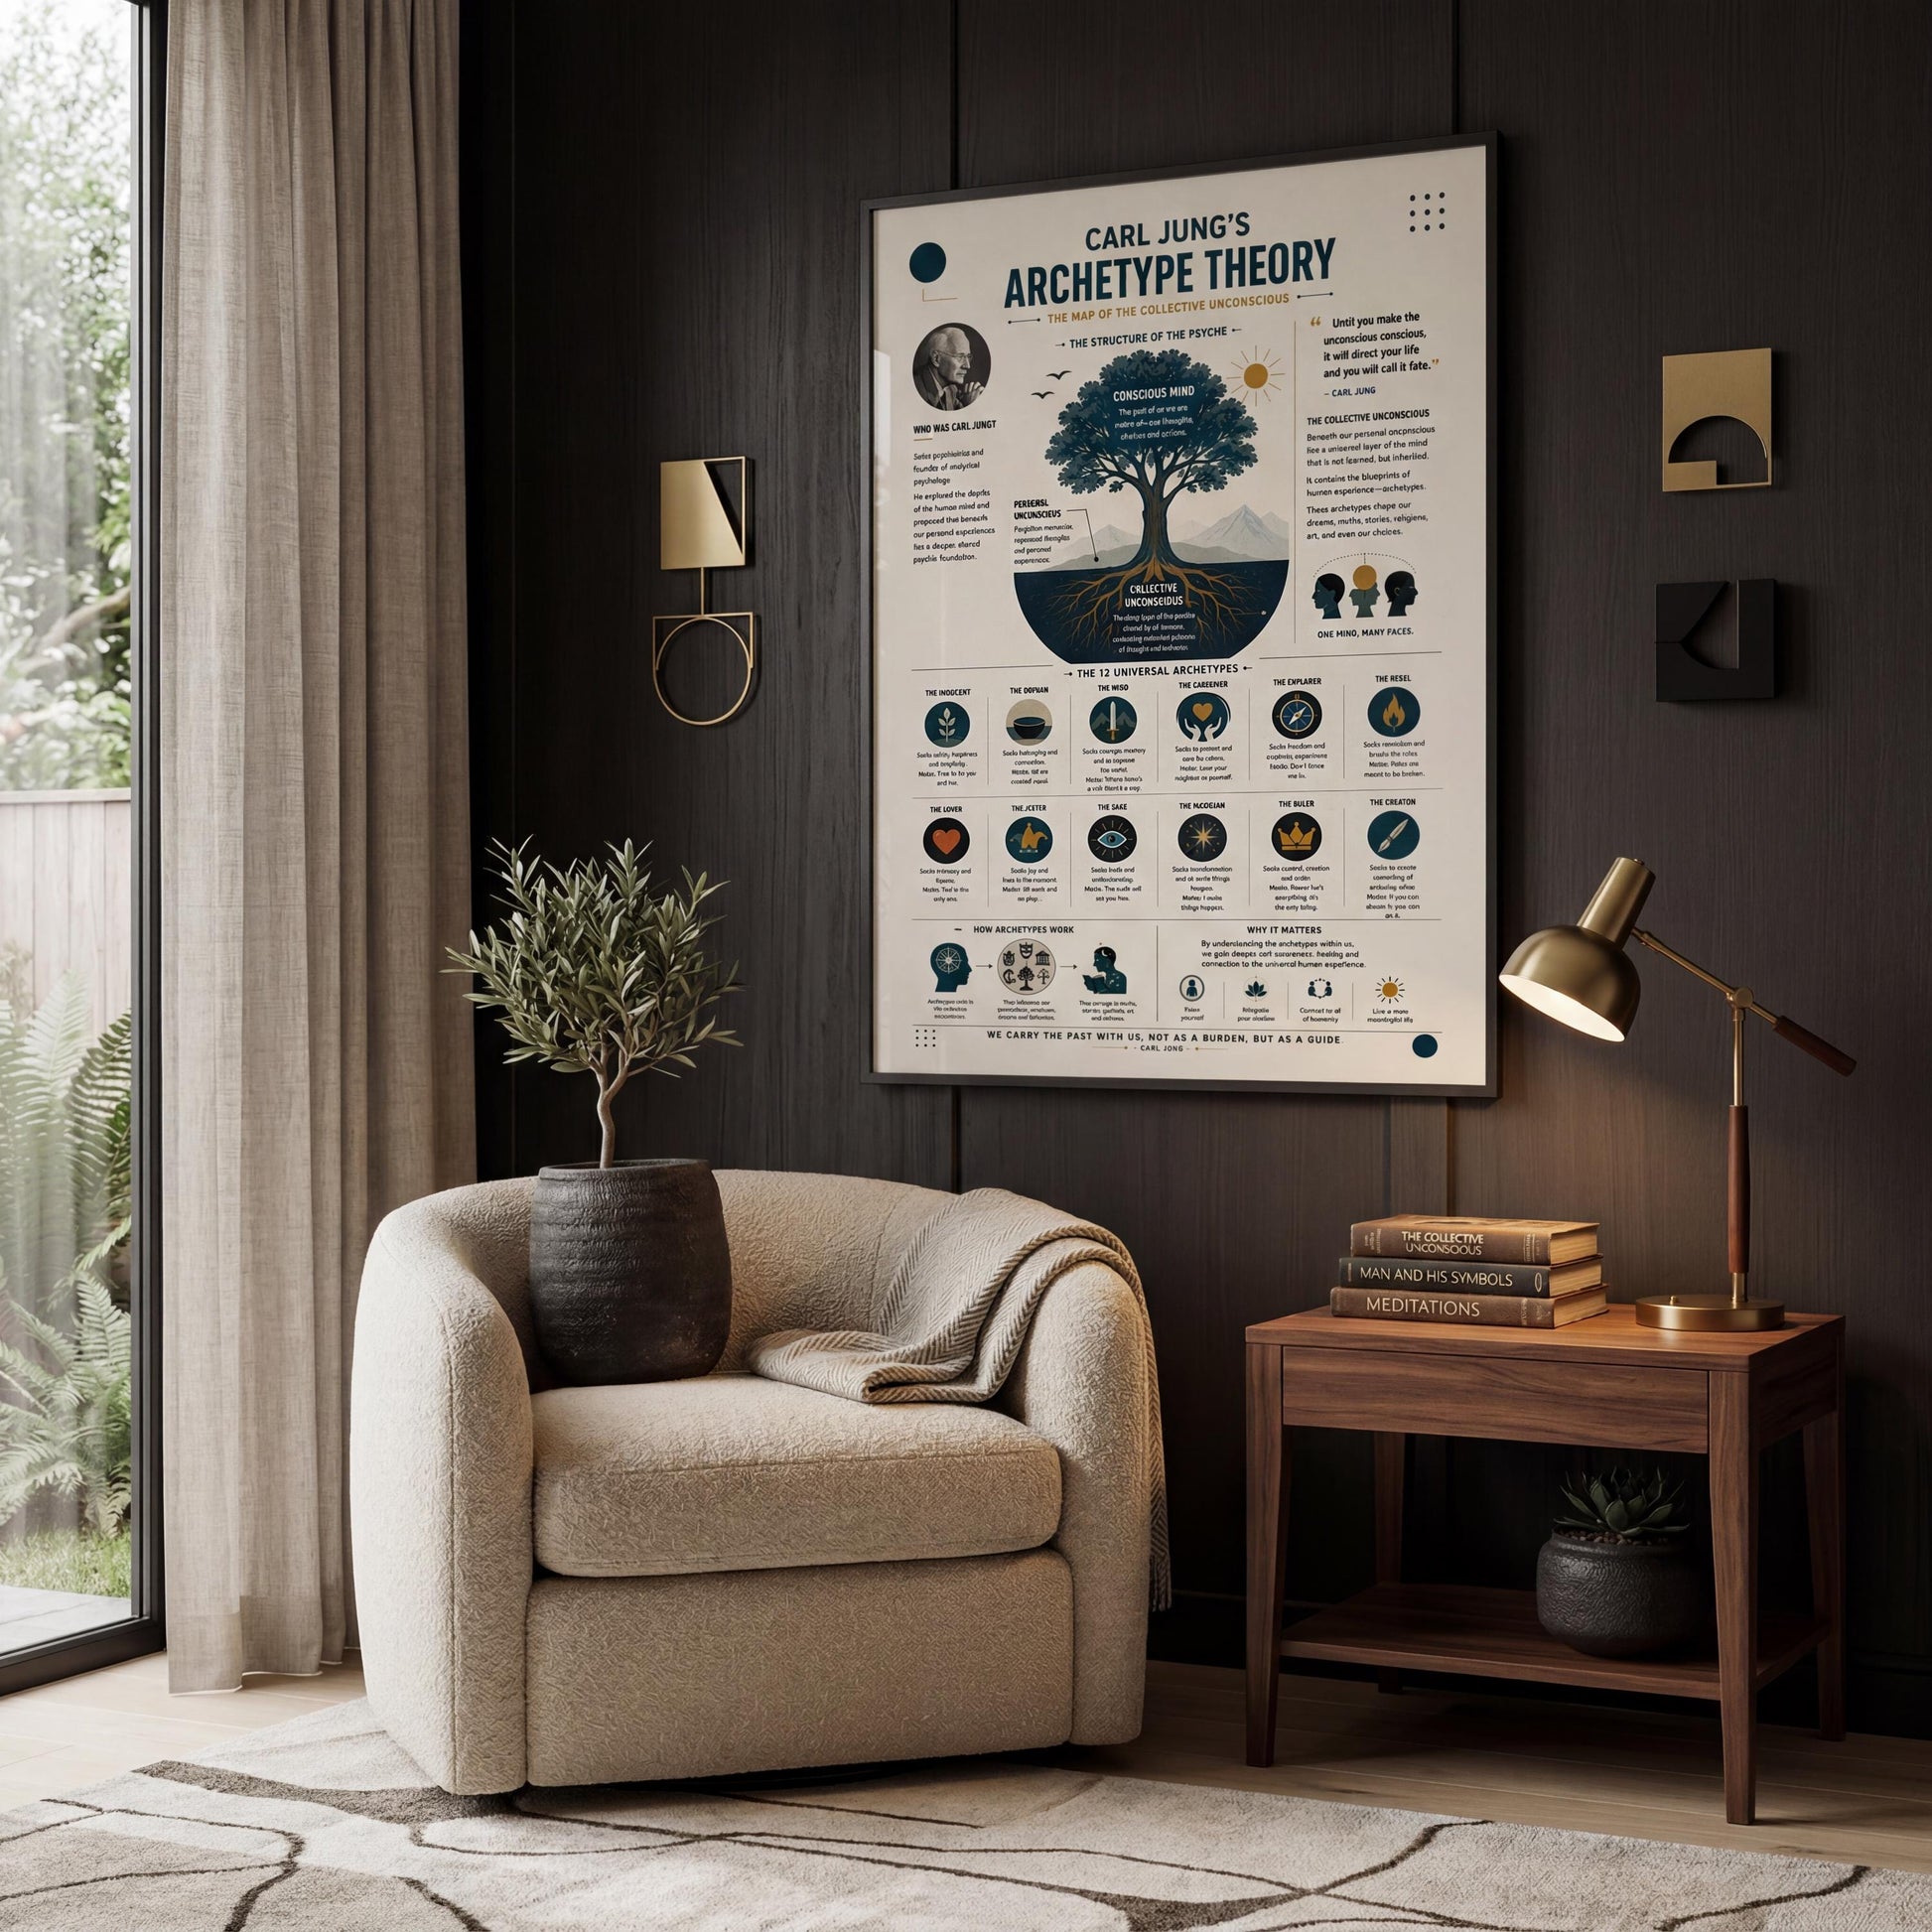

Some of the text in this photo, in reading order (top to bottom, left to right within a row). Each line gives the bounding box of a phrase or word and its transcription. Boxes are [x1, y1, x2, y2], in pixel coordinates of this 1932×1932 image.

[1086, 212, 1250, 250] CARL JUNG'S
[1005, 237, 1336, 308] ARCHETYPE THEORY
[1048, 294, 1289, 324] THE MAP OF THE COLLECTIVE UNCONSCIOUS
[1332, 312, 1420, 329] Until you make the
[1070, 327, 1227, 347] THE STRUCTURE OF THE PSYCHE
[1324, 329, 1427, 345] unconscious conscious,
[1324, 345, 1419, 361] it will direct your life
[1323, 367, 1340, 377] and
[1343, 368, 1359, 379] you
[1362, 364, 1378, 374] will
[1381, 363, 1397, 372] call
[1400, 361, 1406, 371] it
[1114, 385, 1194, 401] CONSCIOUS MIND
[1324, 413, 1370, 424] COLLECTIVE
[1373, 409, 1430, 421] UNCONSCIOUS
[933, 423, 949, 432] WAS
[952, 421, 970, 431] CARL
[1363, 443, 1381, 453] layer
[1100, 668, 1110, 677] 12
[1114, 666, 1170, 676] UNIVERSAL
[1173, 664, 1239, 675] ARCHETYPES
[1202, 1035, 1248, 1043] BURDEN,
[1402, 1231, 1422, 1241] THE
[1360, 1267, 1513, 1287] MAN AND HIS SYMBOLS
[1367, 1297, 1480, 1316] MEDITATIONS
